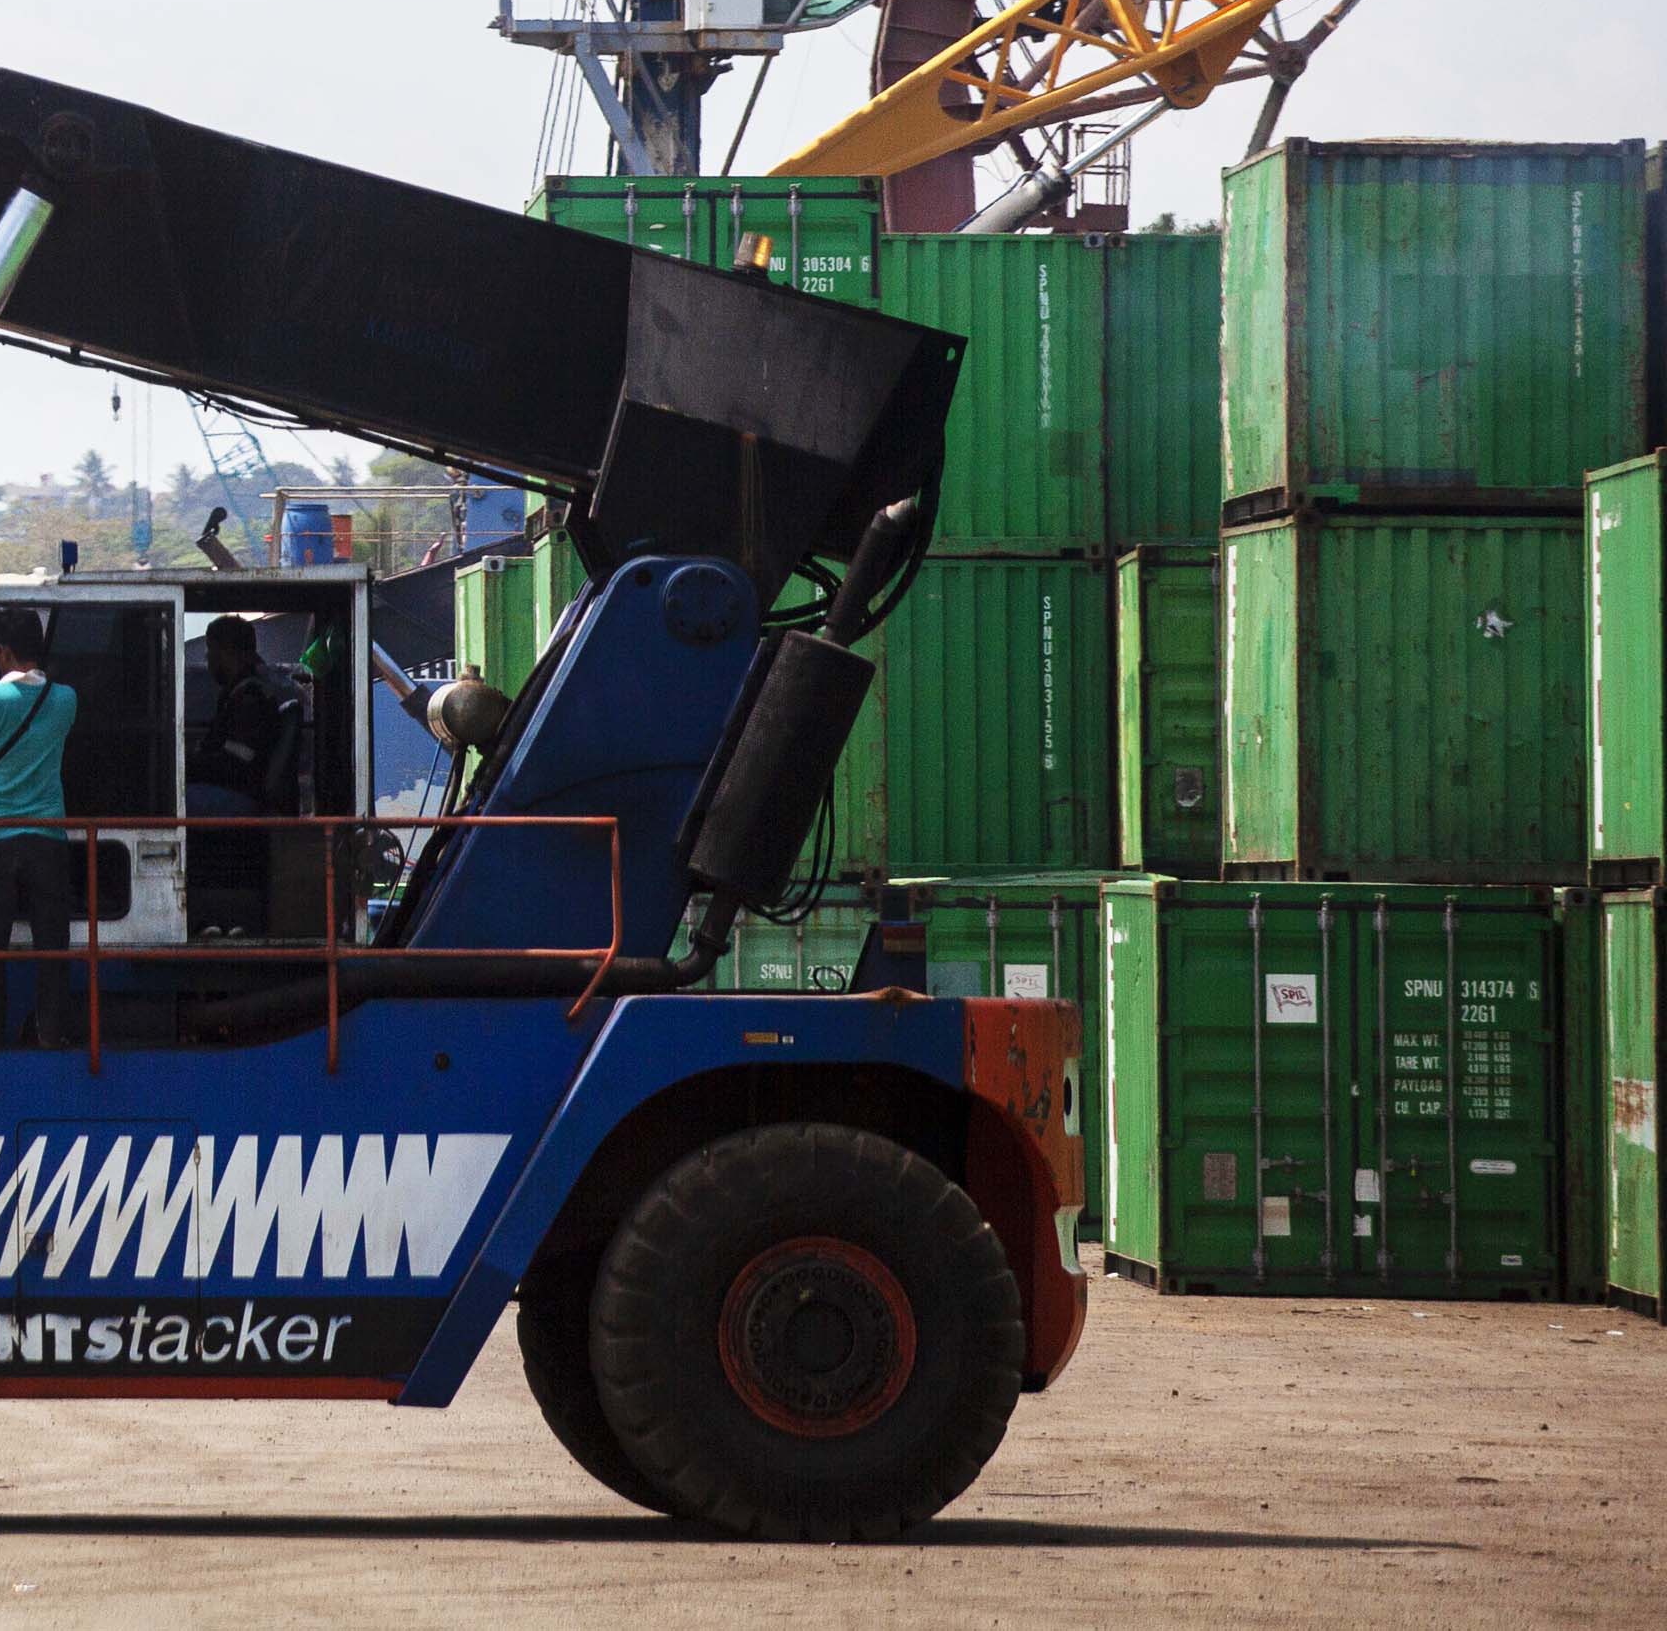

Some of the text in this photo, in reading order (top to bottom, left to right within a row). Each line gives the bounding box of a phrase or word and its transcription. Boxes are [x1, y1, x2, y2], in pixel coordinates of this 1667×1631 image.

[770, 256, 870, 273] NU 305304 6
[802, 277, 834, 293] 22G1
[1042, 596, 1053, 656] SPNU
[1044, 659, 1054, 748] 303155
[760, 965, 793, 981] SPNU
[1281, 988, 1306, 1000] SPIL
[1404, 980, 1443, 998] SPNU
[1461, 980, 1515, 999] 314374
[1461, 1005, 1496, 1023] 22G1
[1395, 1056, 1418, 1069] TARE
[1394, 1078, 1443, 1093] PAYLOAD
